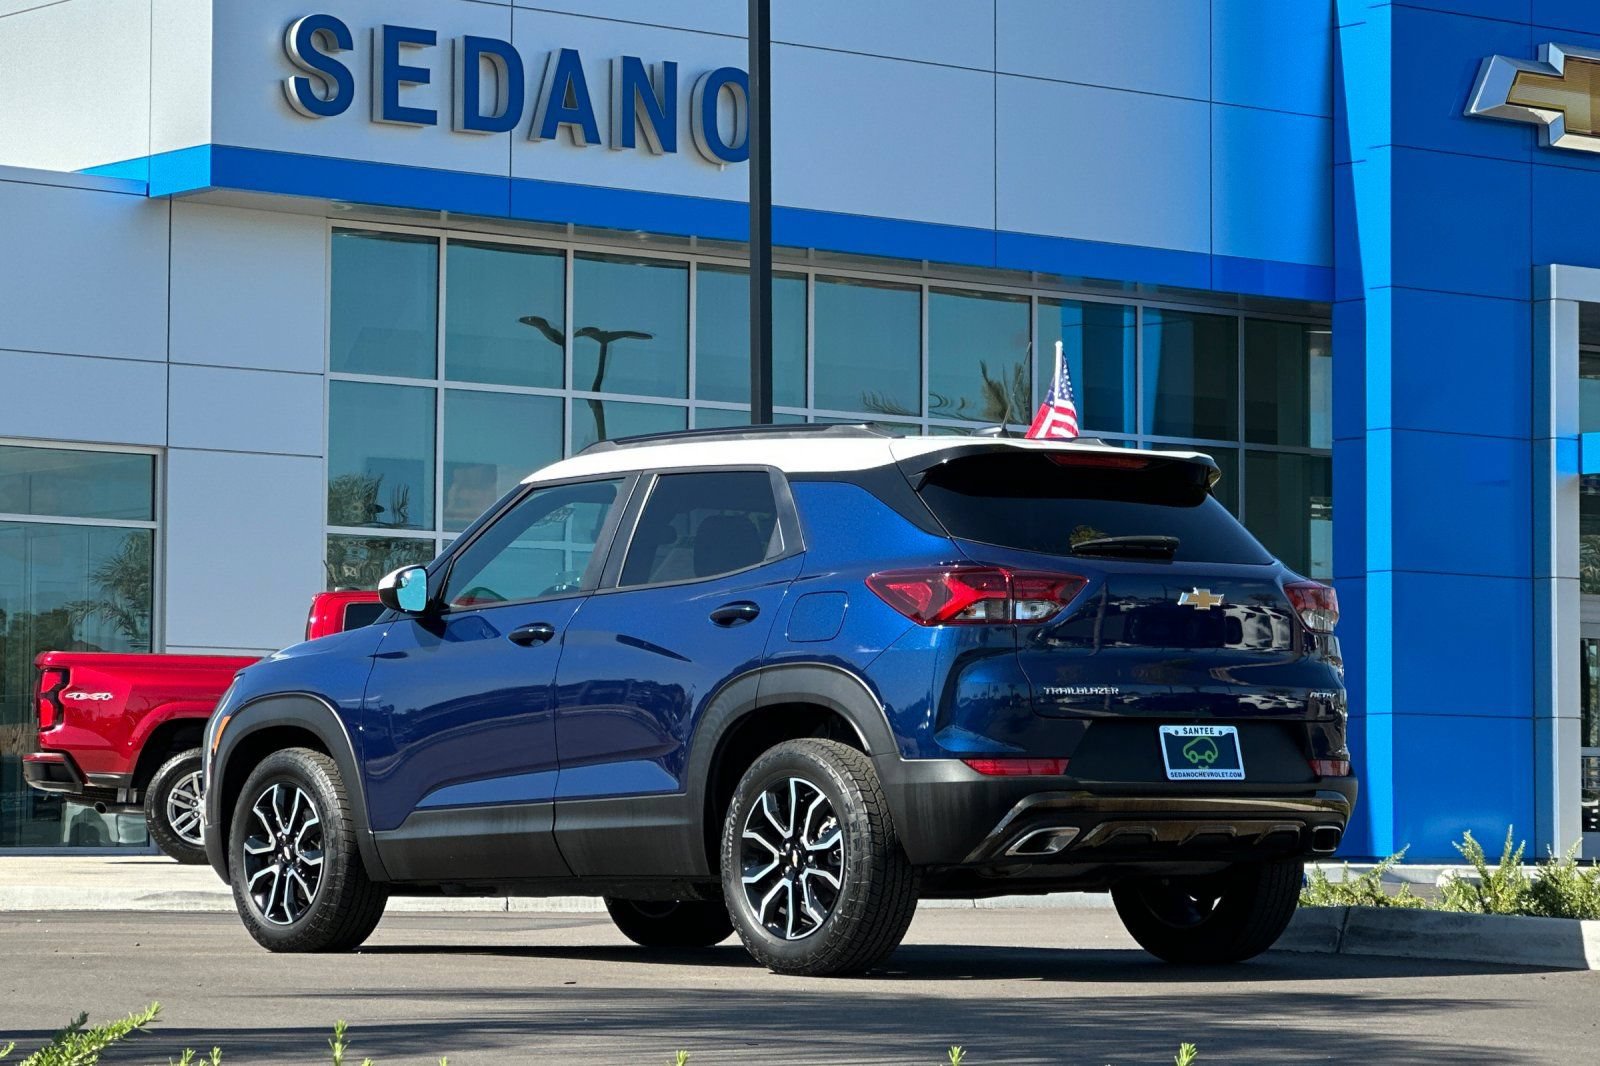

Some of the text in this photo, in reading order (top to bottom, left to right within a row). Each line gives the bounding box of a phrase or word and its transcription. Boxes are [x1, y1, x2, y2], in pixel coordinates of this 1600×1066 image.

[286, 14, 750, 162] SEDANO
[1044, 686, 1120, 696] TRAILBLAZER
[1182, 726, 1215, 735] SANTEE
